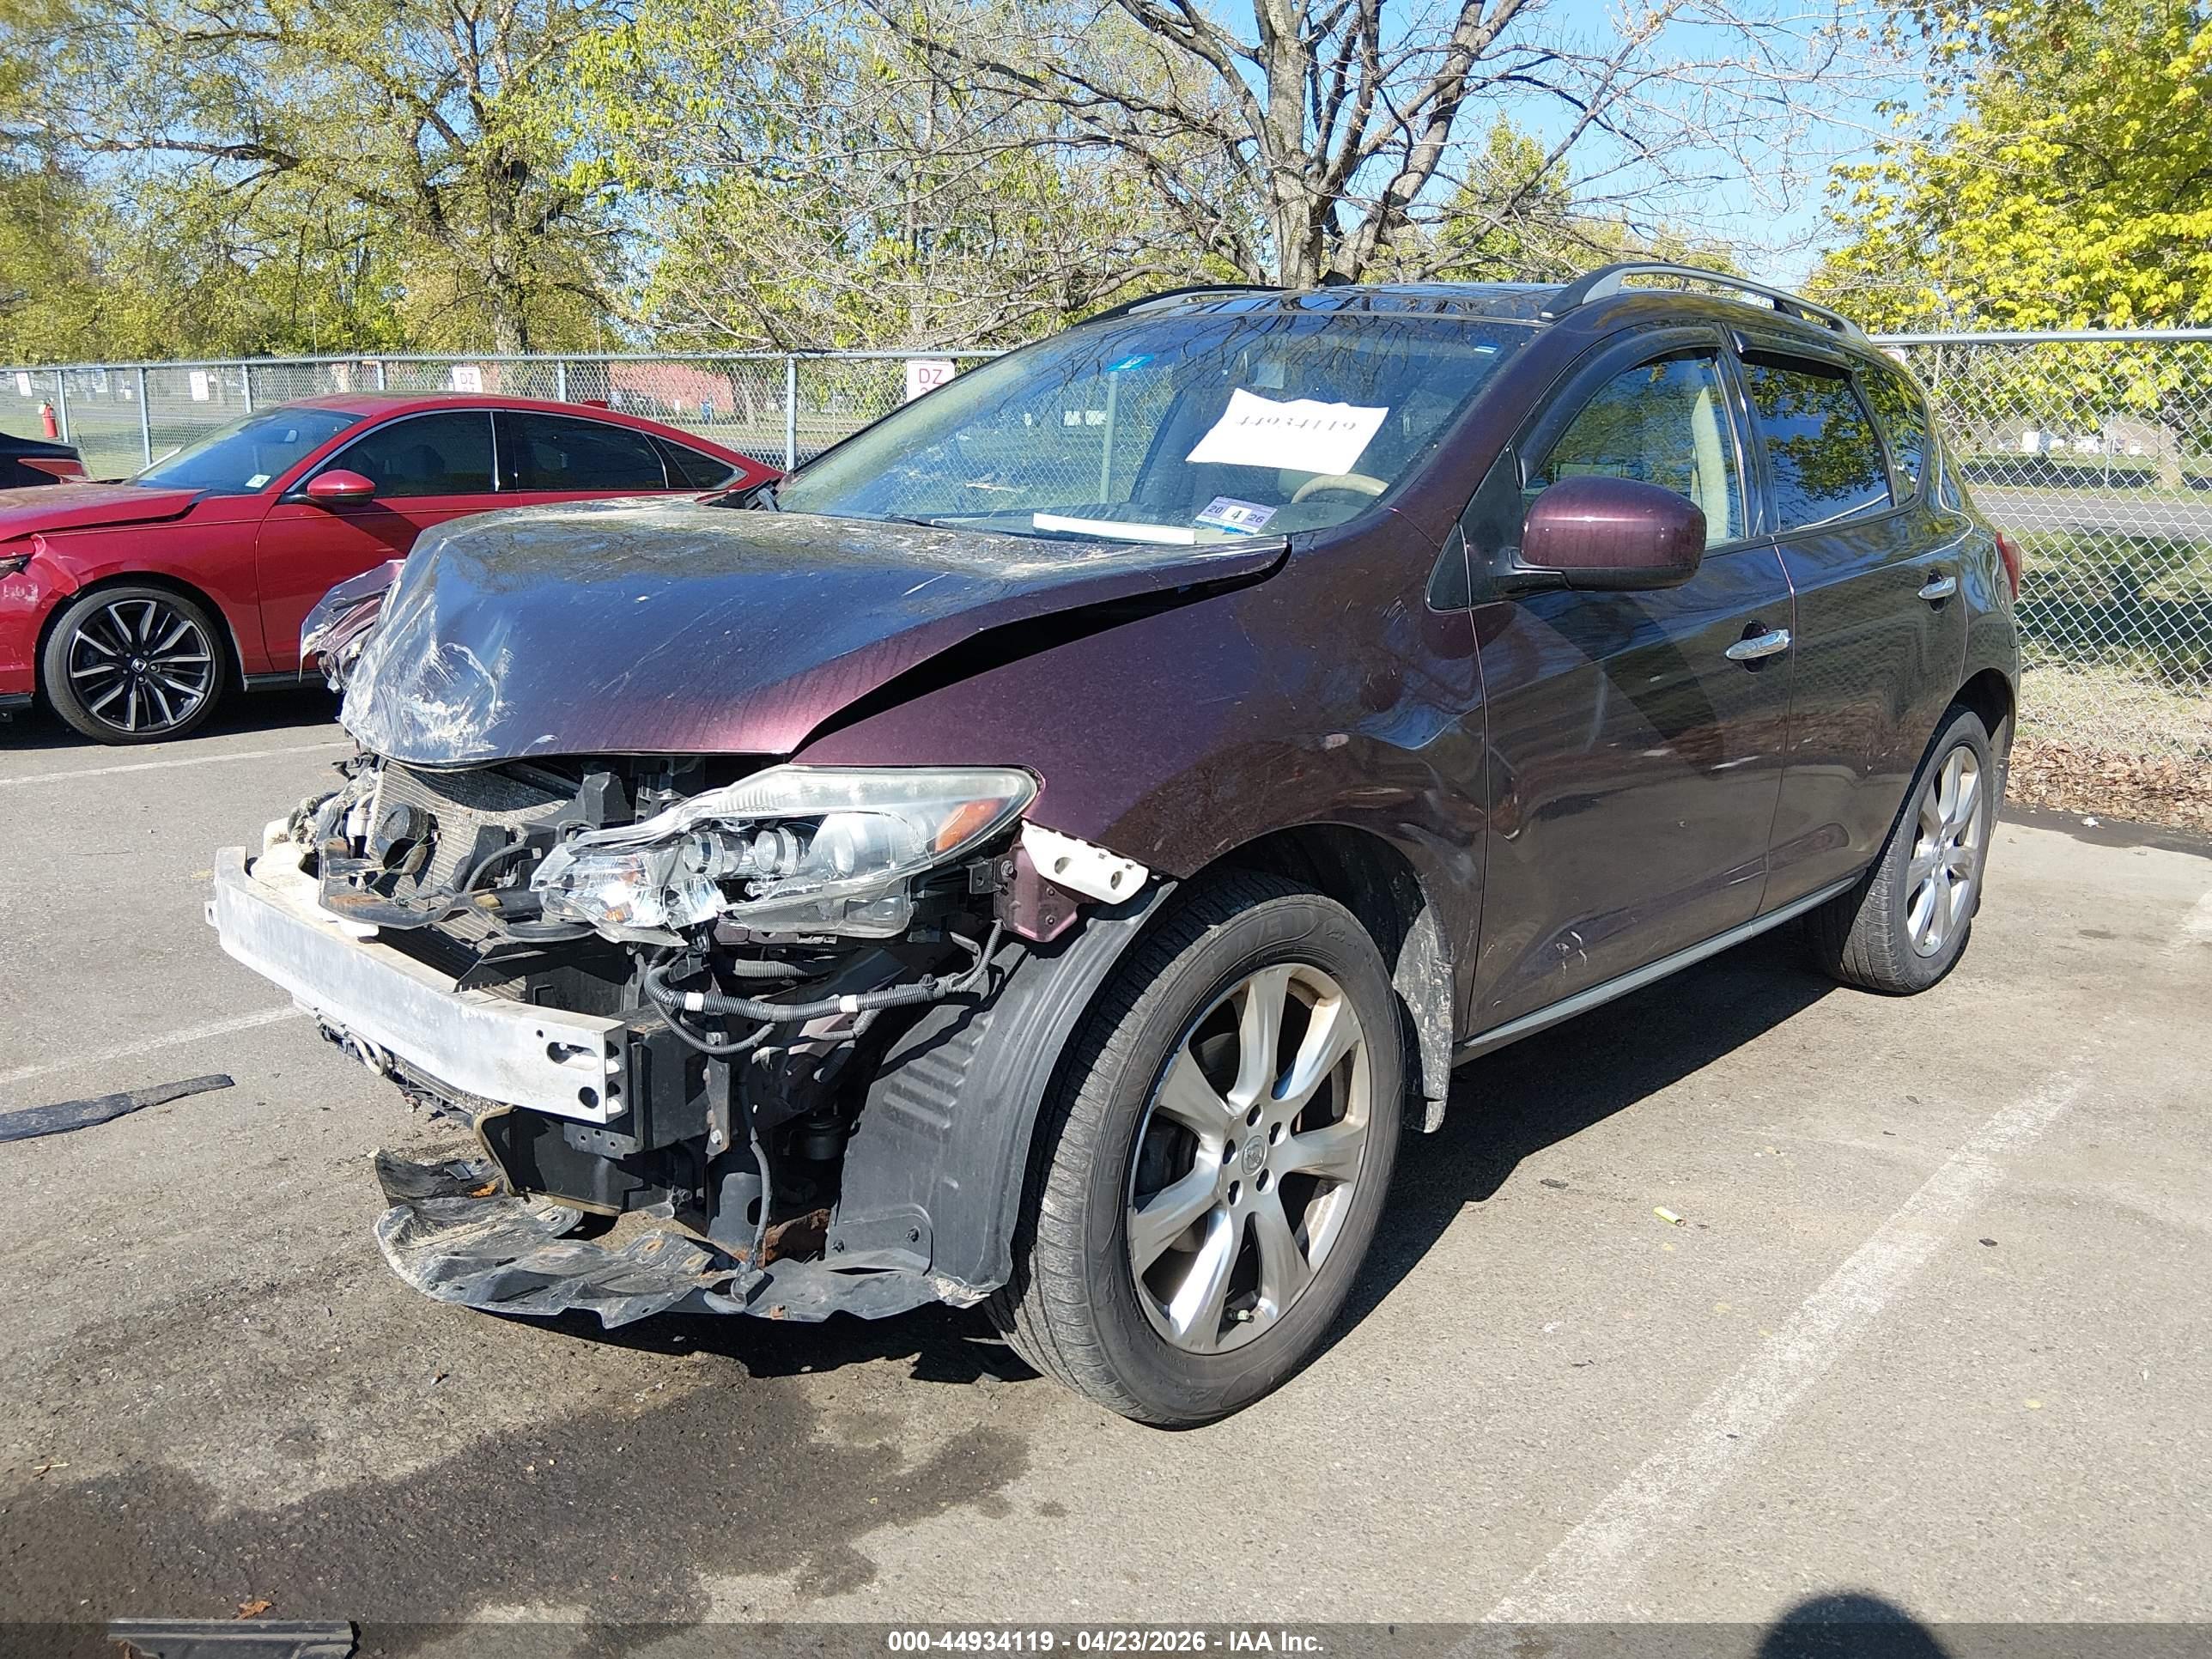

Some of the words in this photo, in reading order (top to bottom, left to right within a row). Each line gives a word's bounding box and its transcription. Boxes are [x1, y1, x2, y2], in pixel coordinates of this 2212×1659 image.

[459, 373, 475, 384] DZ
[919, 368, 943, 385] DZ
[1208, 505, 1224, 514] 20
[1231, 510, 1243, 520] 4
[1248, 514, 1265, 523] 26
